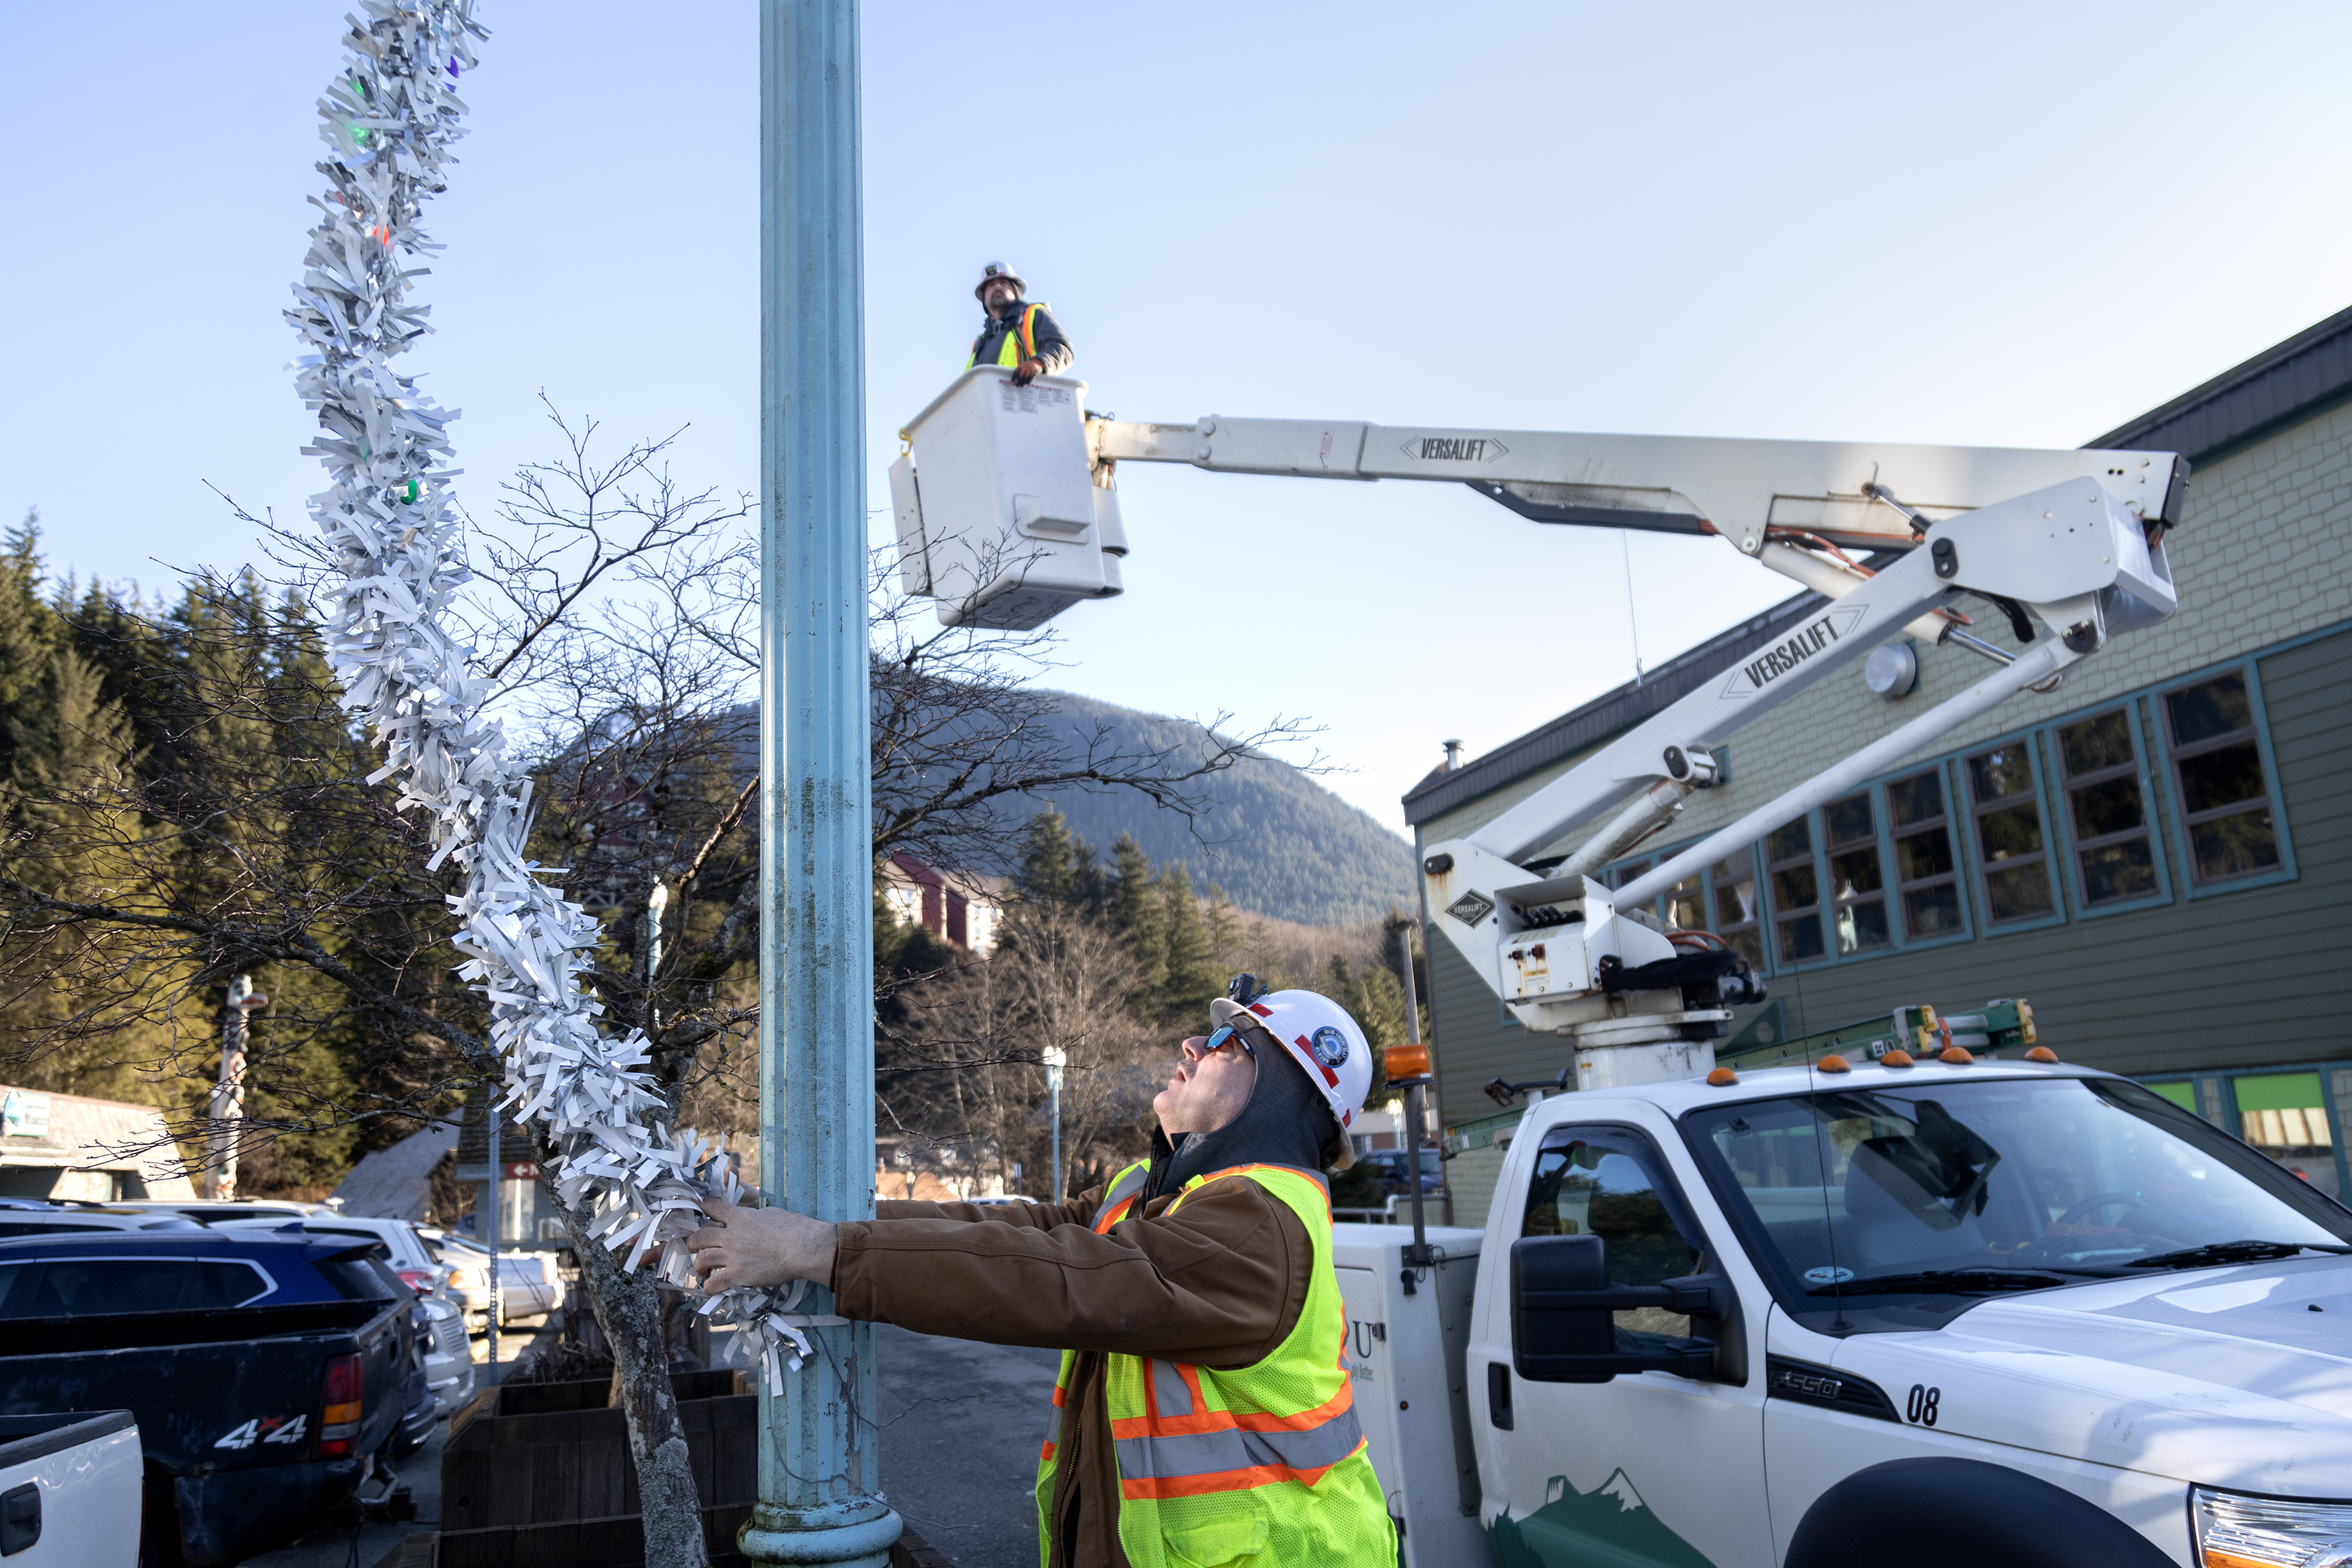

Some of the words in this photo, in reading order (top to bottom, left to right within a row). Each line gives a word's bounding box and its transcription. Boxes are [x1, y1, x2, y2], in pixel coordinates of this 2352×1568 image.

[1421, 438, 1487, 461] VERSALIFT
[1744, 615, 1840, 688] VERSALIFT
[1454, 903, 1483, 914] VERSALIFT
[1907, 1383, 1941, 1427] 08
